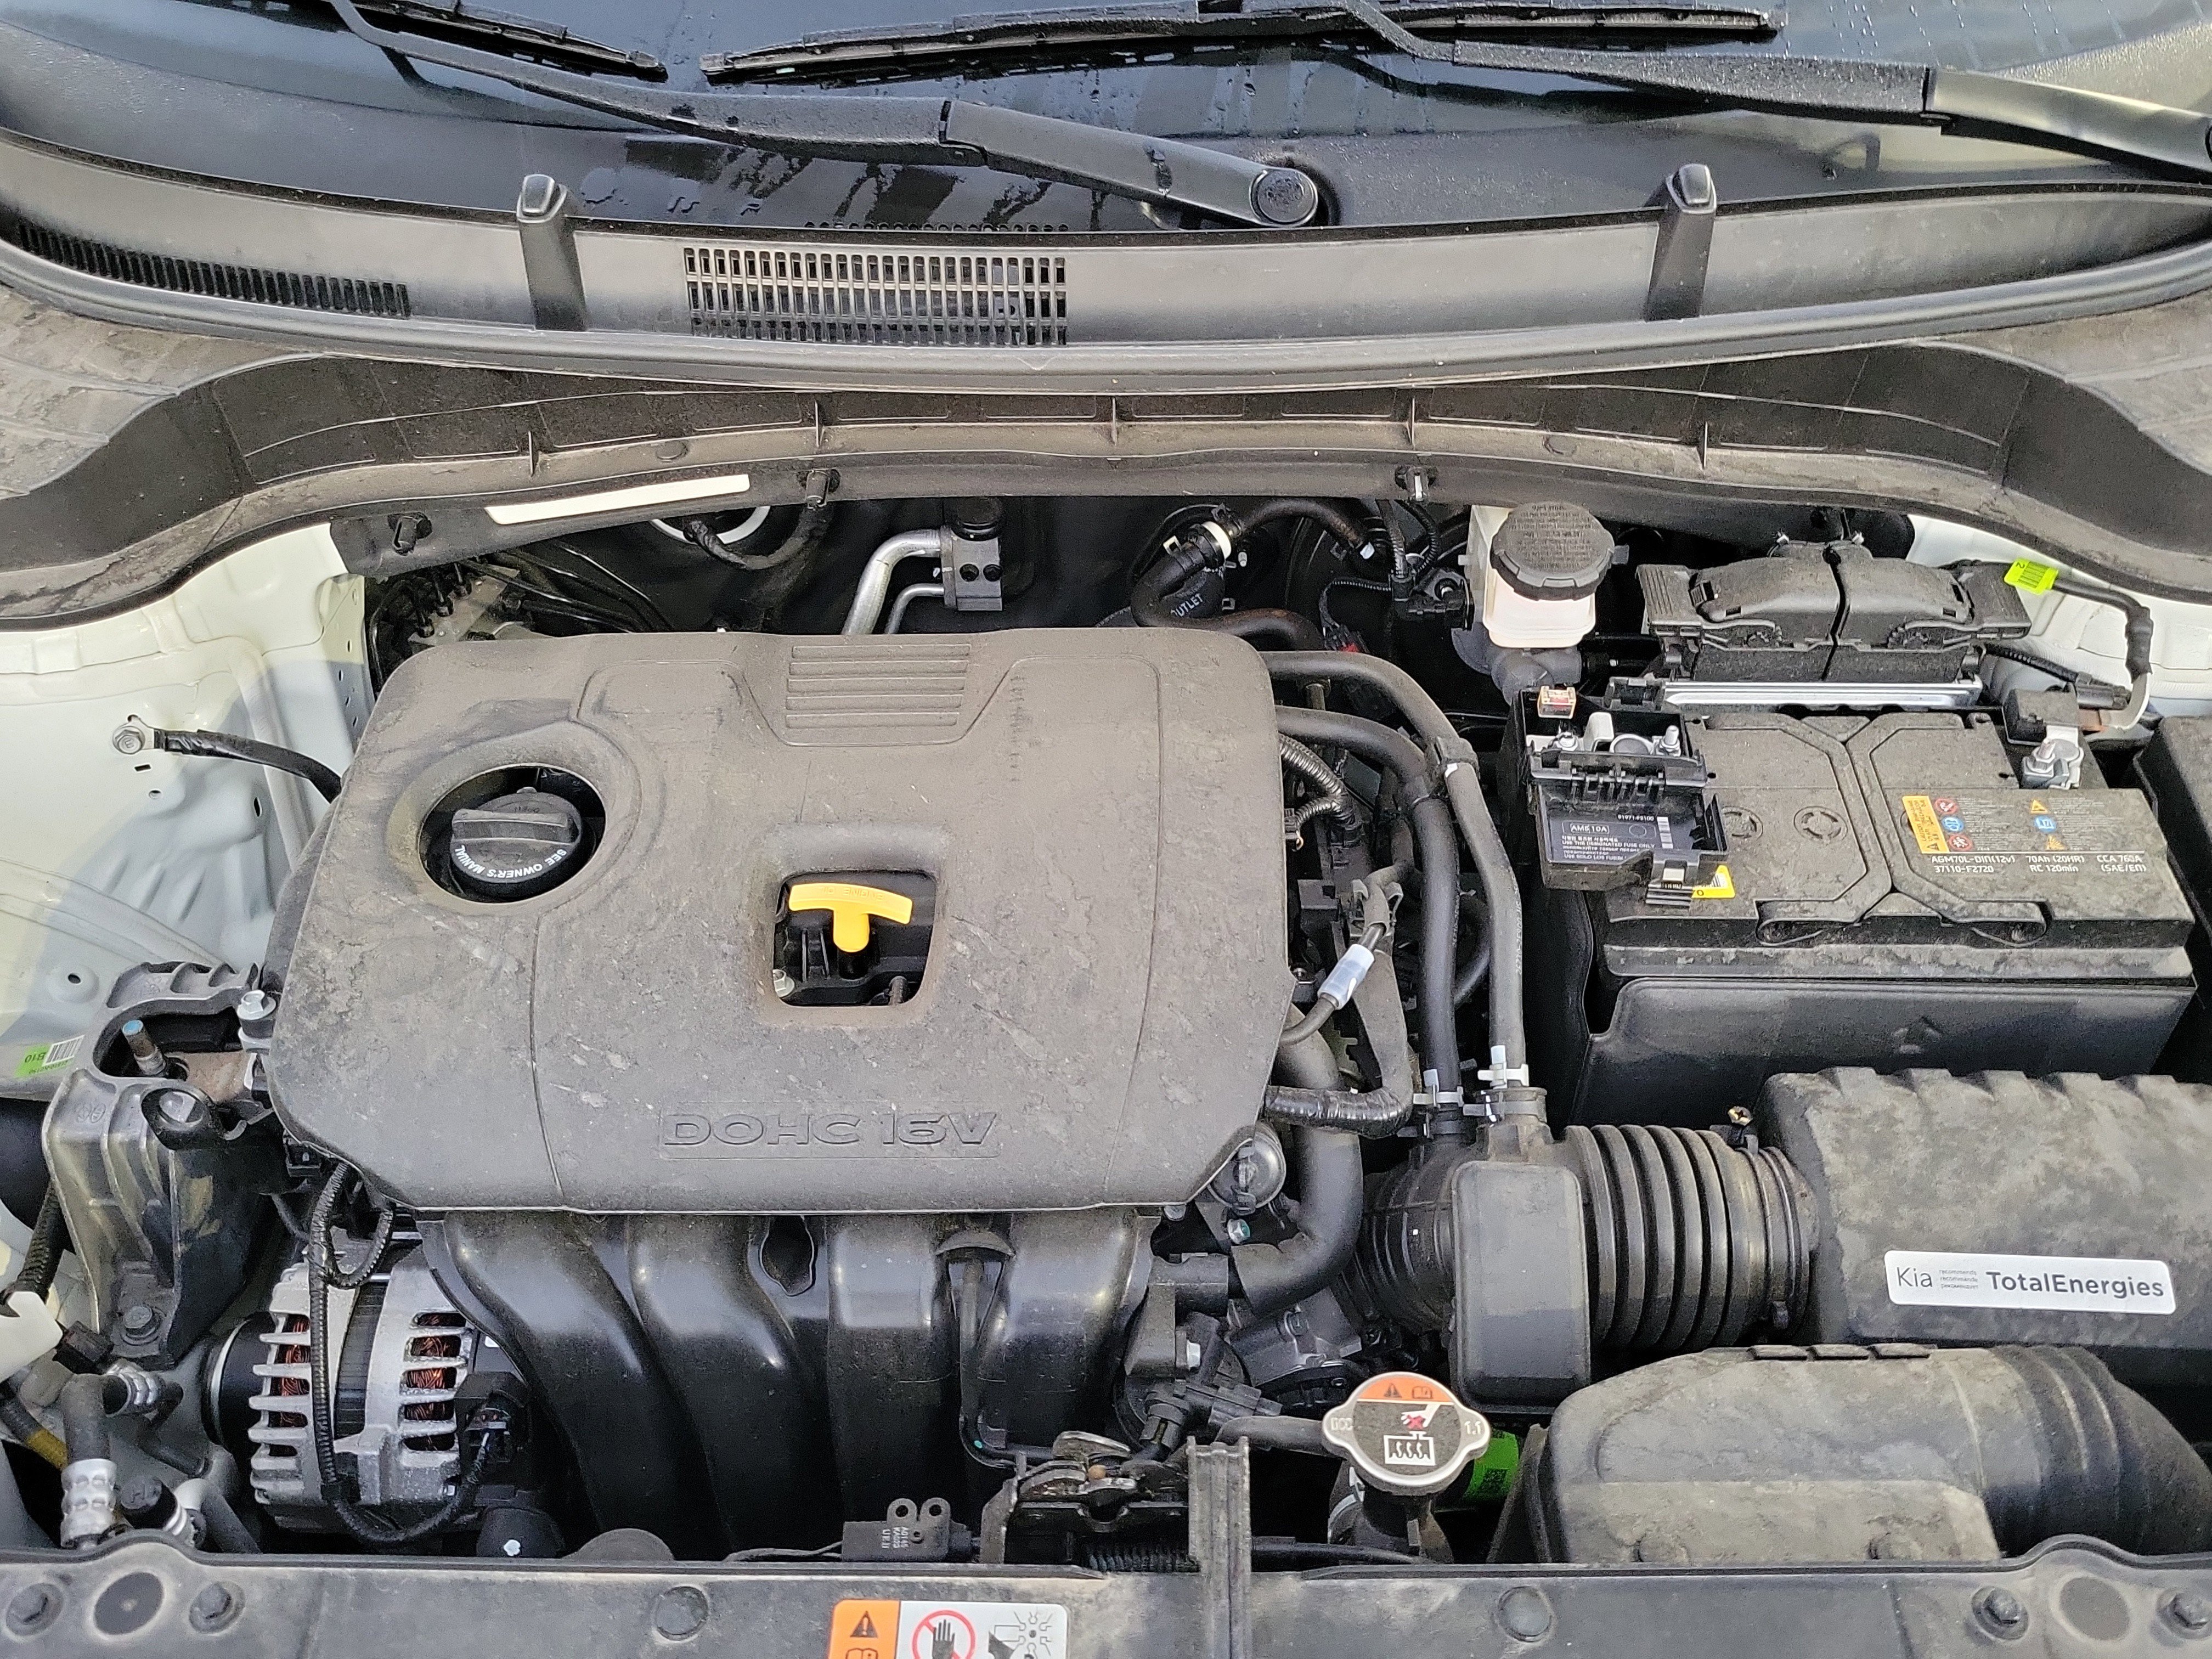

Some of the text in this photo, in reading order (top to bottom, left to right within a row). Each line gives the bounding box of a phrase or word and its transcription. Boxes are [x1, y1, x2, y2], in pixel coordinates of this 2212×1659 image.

[454, 845, 567, 878] SEE OWNER'S MANUAL
[843, 887, 884, 901] ENGINE
[664, 1113, 997, 1146] DOHC 16V
[1896, 1266, 1933, 1288] Kia
[1985, 1271, 2164, 1299] TotalEnergies
